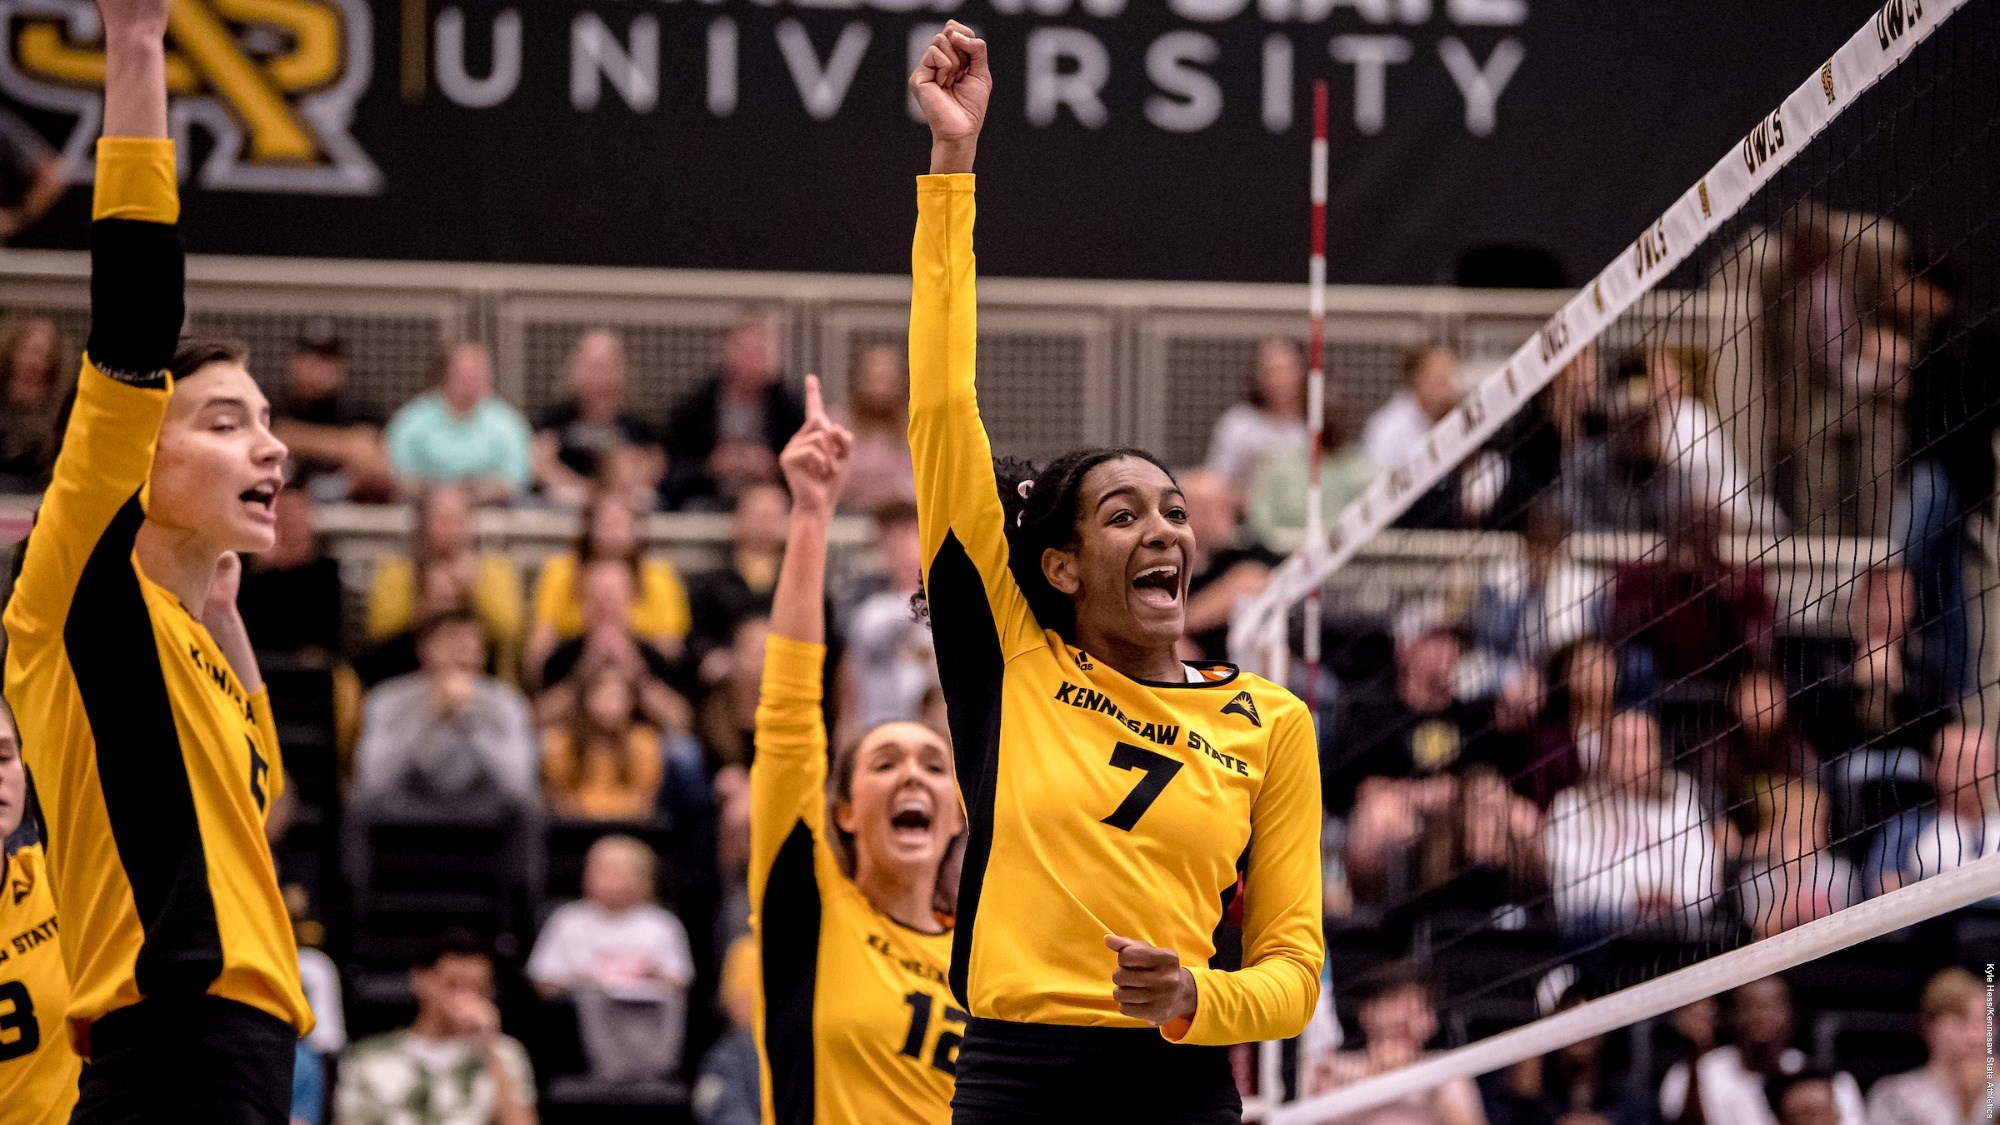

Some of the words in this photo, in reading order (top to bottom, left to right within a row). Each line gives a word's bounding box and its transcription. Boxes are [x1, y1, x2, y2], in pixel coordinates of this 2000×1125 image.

[434, 6, 1527, 136] UNIVRSITY
[1743, 105, 1785, 176] OWLS
[1054, 680, 1180, 746] KENNESAW
[1187, 730, 1249, 777] STATE
[1100, 740, 1185, 832] 7
